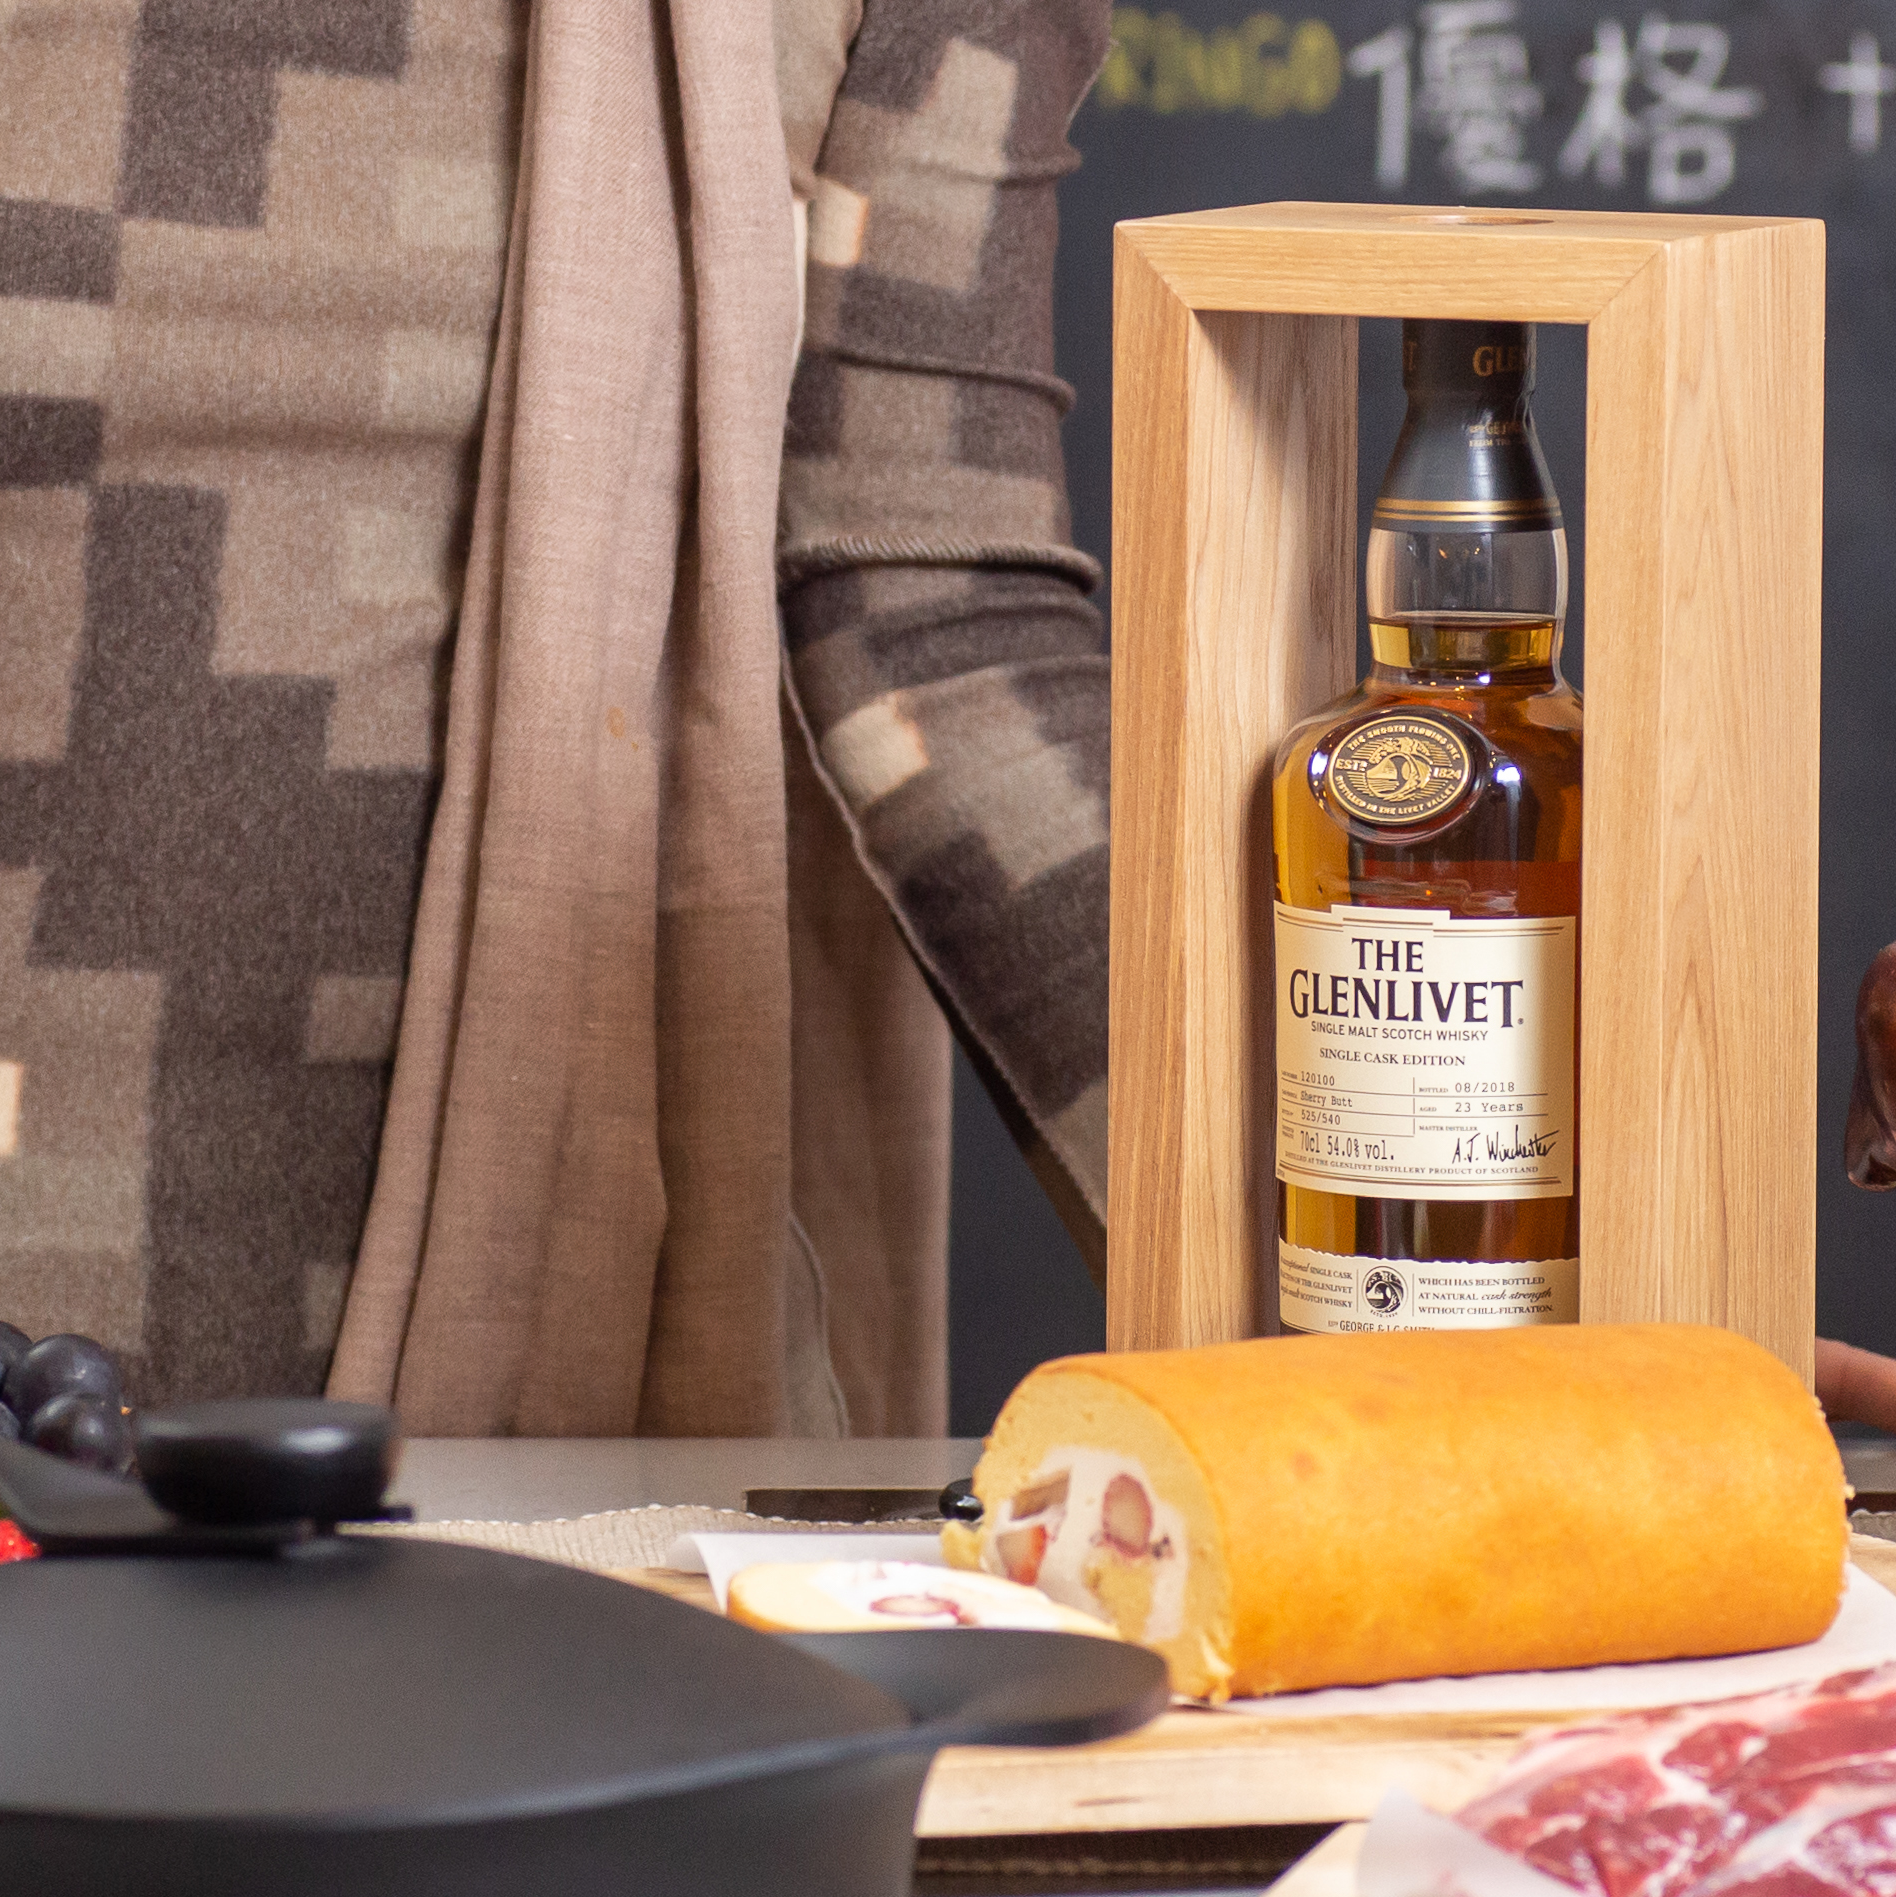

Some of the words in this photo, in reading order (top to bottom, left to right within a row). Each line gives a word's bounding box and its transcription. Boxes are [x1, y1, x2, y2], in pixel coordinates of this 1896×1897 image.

[1432, 766, 1463, 780] 1824
[1351, 937, 1424, 973] THE
[1311, 1020, 1345, 1036] SINGLE
[1348, 1025, 1379, 1039] MALT
[1381, 1027, 1432, 1042] SCOTCH
[1436, 1029, 1489, 1042] WHISKY
[1319, 1046, 1361, 1063] SINGLE
[1363, 1052, 1399, 1066] CASK
[1402, 1054, 1466, 1067] EDITION
[1300, 1070, 1335, 1087] 120100
[1454, 1081, 1516, 1093] 08/2018
[1331, 1095, 1353, 1108] Butt
[1455, 1101, 1472, 1113] 23
[1481, 1102, 1524, 1113] Years
[1301, 1108, 1341, 1126] 525/540
[1326, 1134, 1360, 1159] 54.0%
[1364, 1138, 1394, 1161] vol.
[1330, 1159, 1373, 1172] GLENLIVET
[1374, 1165, 1426, 1175] DISTILLERY
[1428, 1166, 1473, 1176] PRODUCT
[1475, 1166, 1490, 1176] OF
[1490, 1164, 1540, 1176] SCOTLAND
[1332, 1270, 1354, 1281] CASK
[1418, 1277, 1453, 1287] WHICH
[1454, 1279, 1474, 1287] HAS
[1475, 1278, 1500, 1287] BEEN
[1502, 1276, 1545, 1286] BOTTLED
[1313, 1280, 1354, 1295] GLENLIVET
[1323, 1294, 1354, 1309] WHISKY
[1418, 1292, 1431, 1301] AT
[1432, 1292, 1479, 1301] NATURAL
[1508, 1287, 1553, 1304] strength
[1418, 1306, 1466, 1315] WITHOUT
